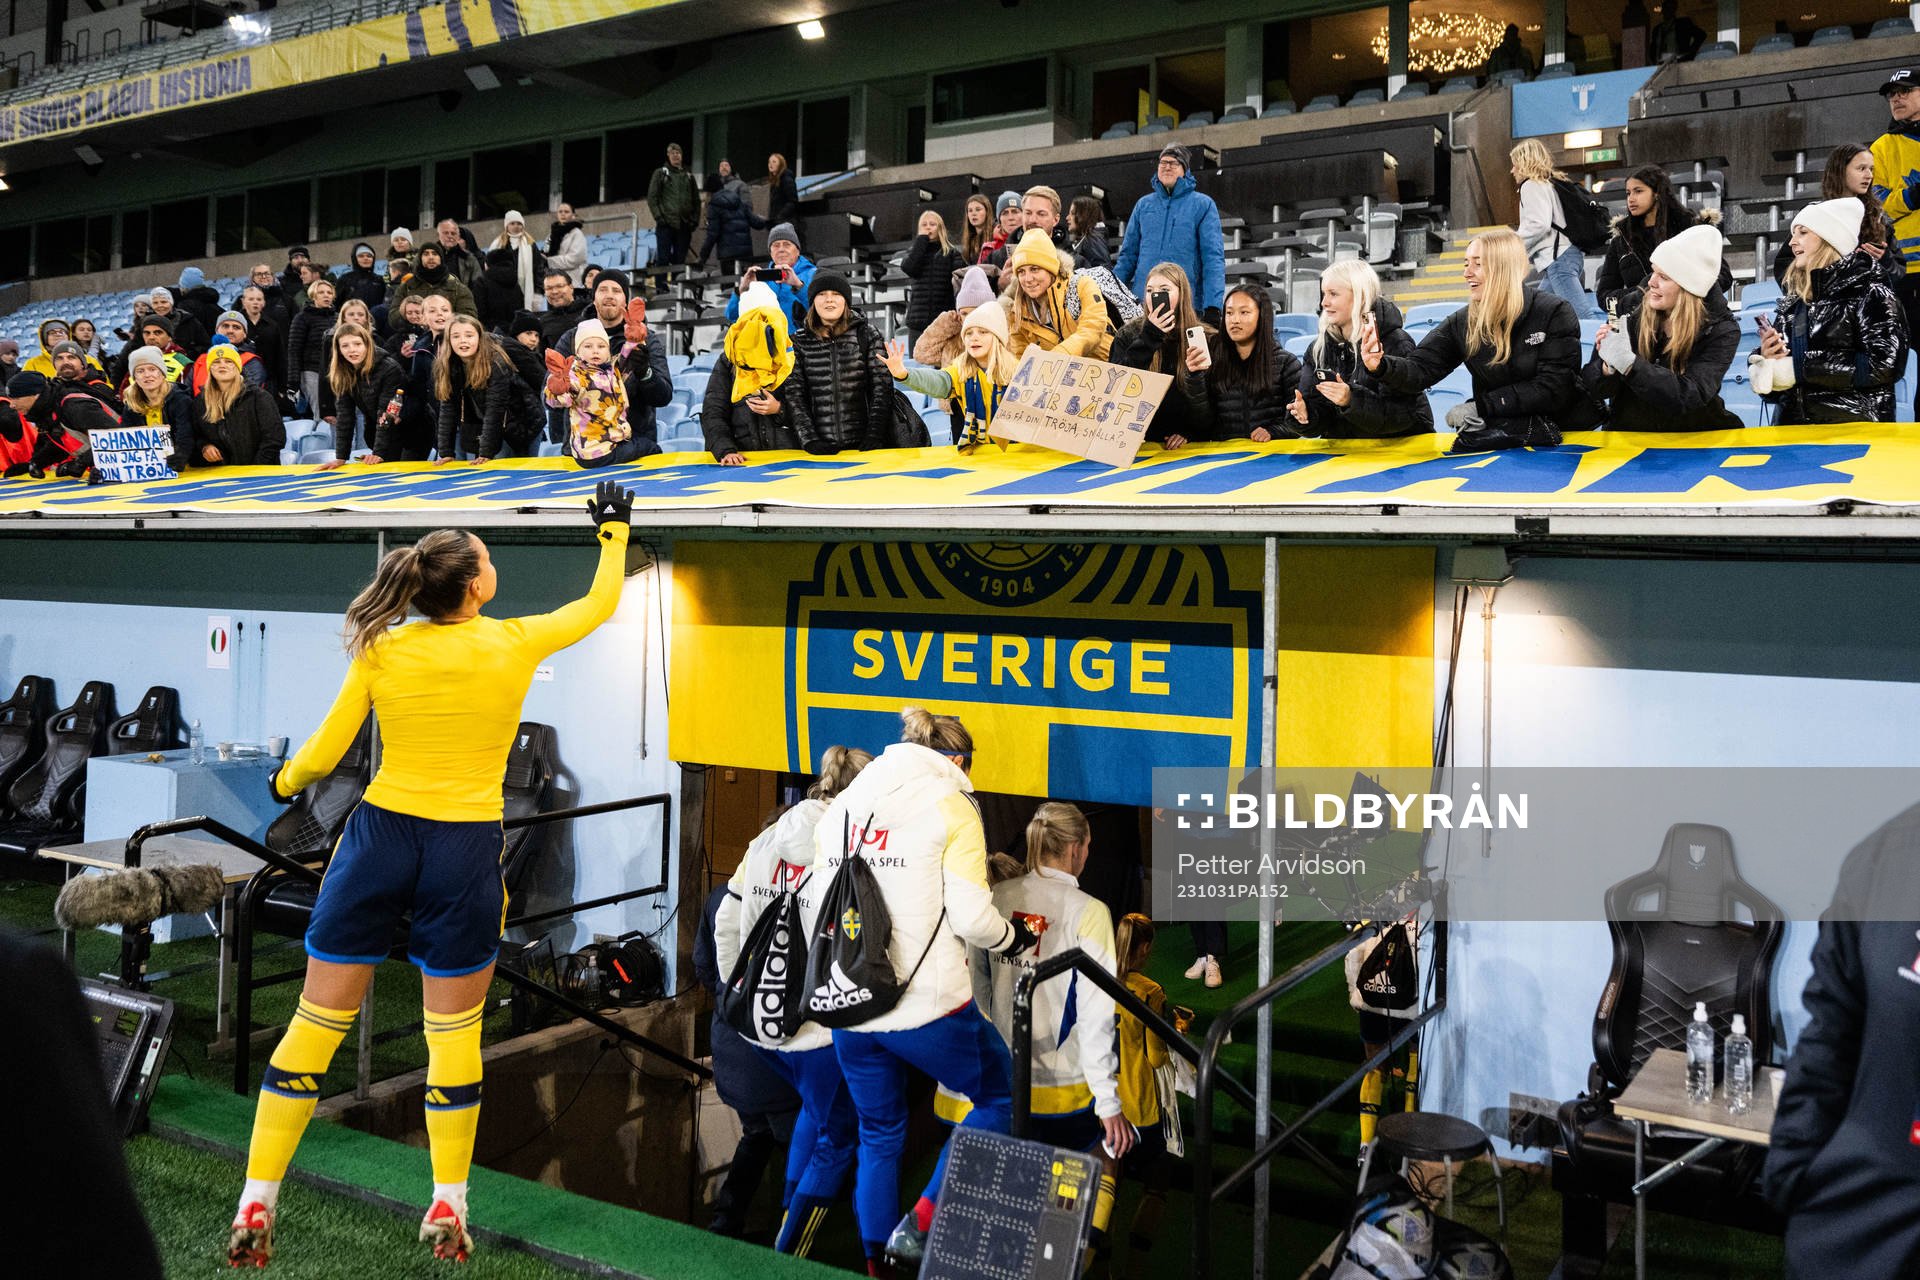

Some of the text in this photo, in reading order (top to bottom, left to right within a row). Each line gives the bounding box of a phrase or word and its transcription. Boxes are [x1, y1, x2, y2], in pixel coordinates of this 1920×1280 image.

[159, 56, 251, 108] HISTORIA
[1006, 386, 1034, 403] DU
[1032, 387, 1061, 411] ÄR
[98, 452, 118, 464] KAN
[120, 451, 142, 464] JAG
[100, 467, 121, 480] DIN
[980, 576, 1035, 598] 1904
[851, 628, 1173, 696] SVERIGE
[879, 857, 907, 868] SPEL
[810, 988, 873, 1012] adidas
